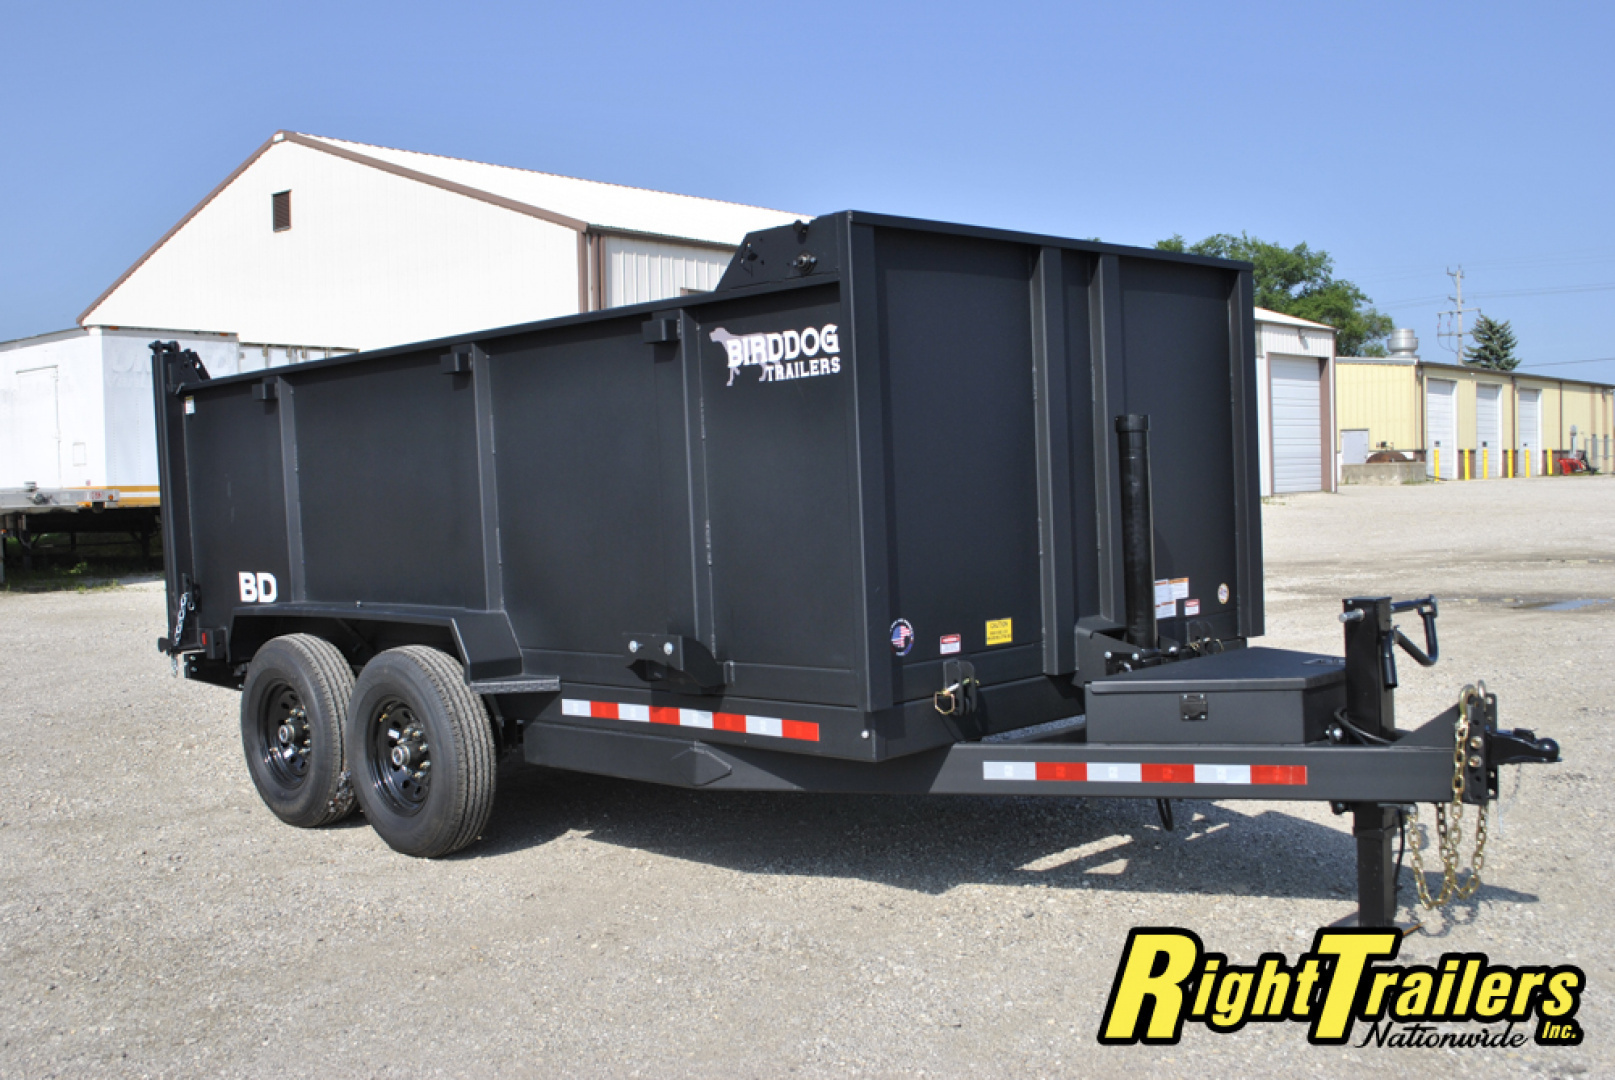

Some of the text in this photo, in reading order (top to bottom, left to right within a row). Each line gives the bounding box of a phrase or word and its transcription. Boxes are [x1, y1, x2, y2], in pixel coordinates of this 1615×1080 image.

[726, 323, 841, 368] BIRDDOG
[766, 356, 841, 382] TRAILERS
[238, 571, 278, 603] BD
